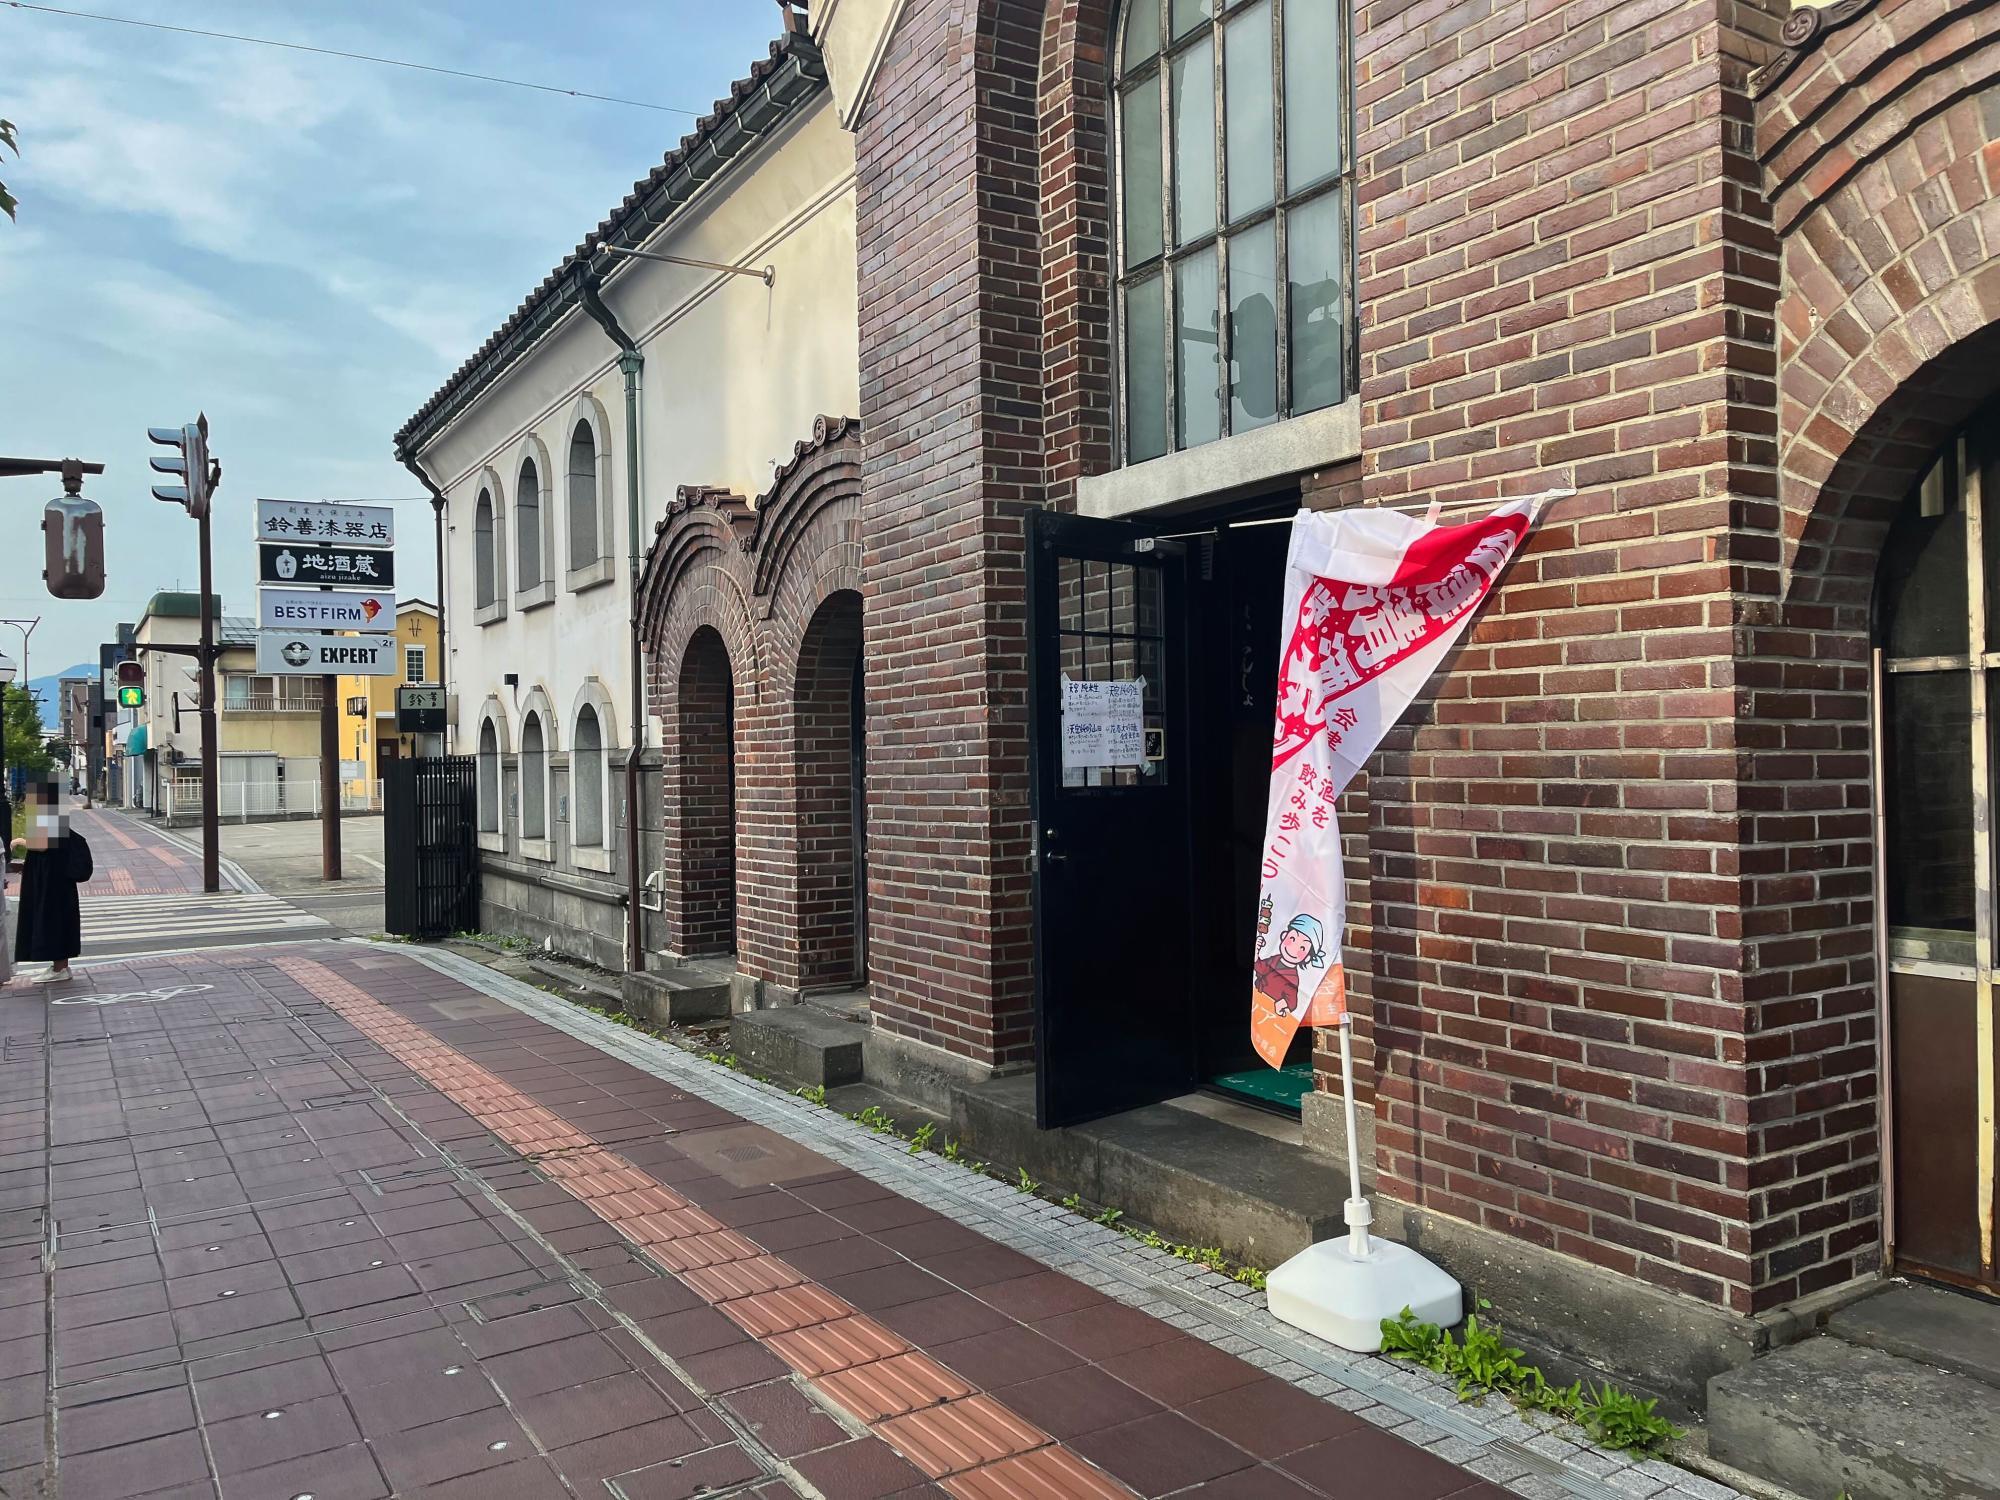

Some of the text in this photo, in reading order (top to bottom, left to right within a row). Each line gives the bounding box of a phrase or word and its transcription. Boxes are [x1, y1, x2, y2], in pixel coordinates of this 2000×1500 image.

[264, 515, 388, 539] 鈴善漆器店
[301, 553, 379, 579] 地酒蔵
[274, 605, 361, 620] BEST FIRM
[382, 639, 394, 648] 2F
[320, 647, 378, 664] EXPERT
